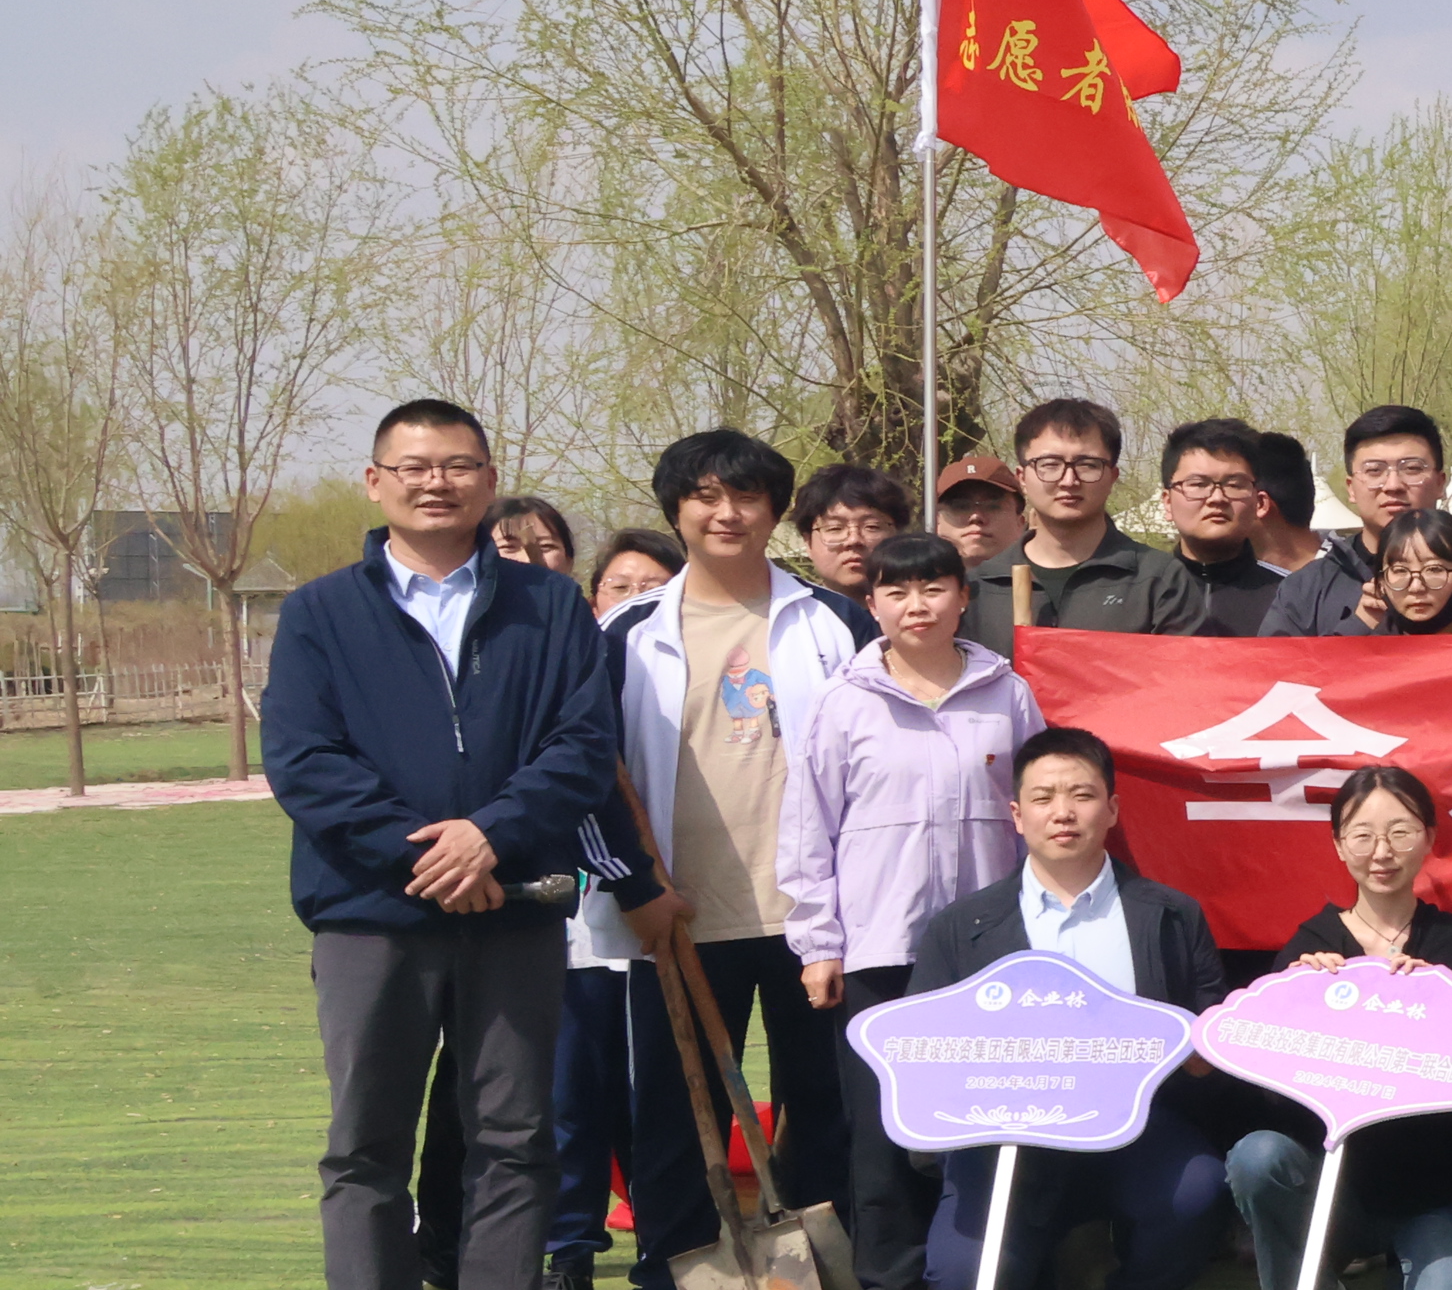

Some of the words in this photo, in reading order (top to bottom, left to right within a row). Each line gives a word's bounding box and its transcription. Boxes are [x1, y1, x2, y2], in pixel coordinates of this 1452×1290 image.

[1017, 989, 1088, 1008] 企业林
[1362, 994, 1427, 1021] 企业林
[883, 1037, 1164, 1063] 宁夏建设投资集团有限公司第三联合团支部
[966, 1076, 1076, 1090] 2024年4月7日
[1293, 1071, 1396, 1100] 2024年4月7日
